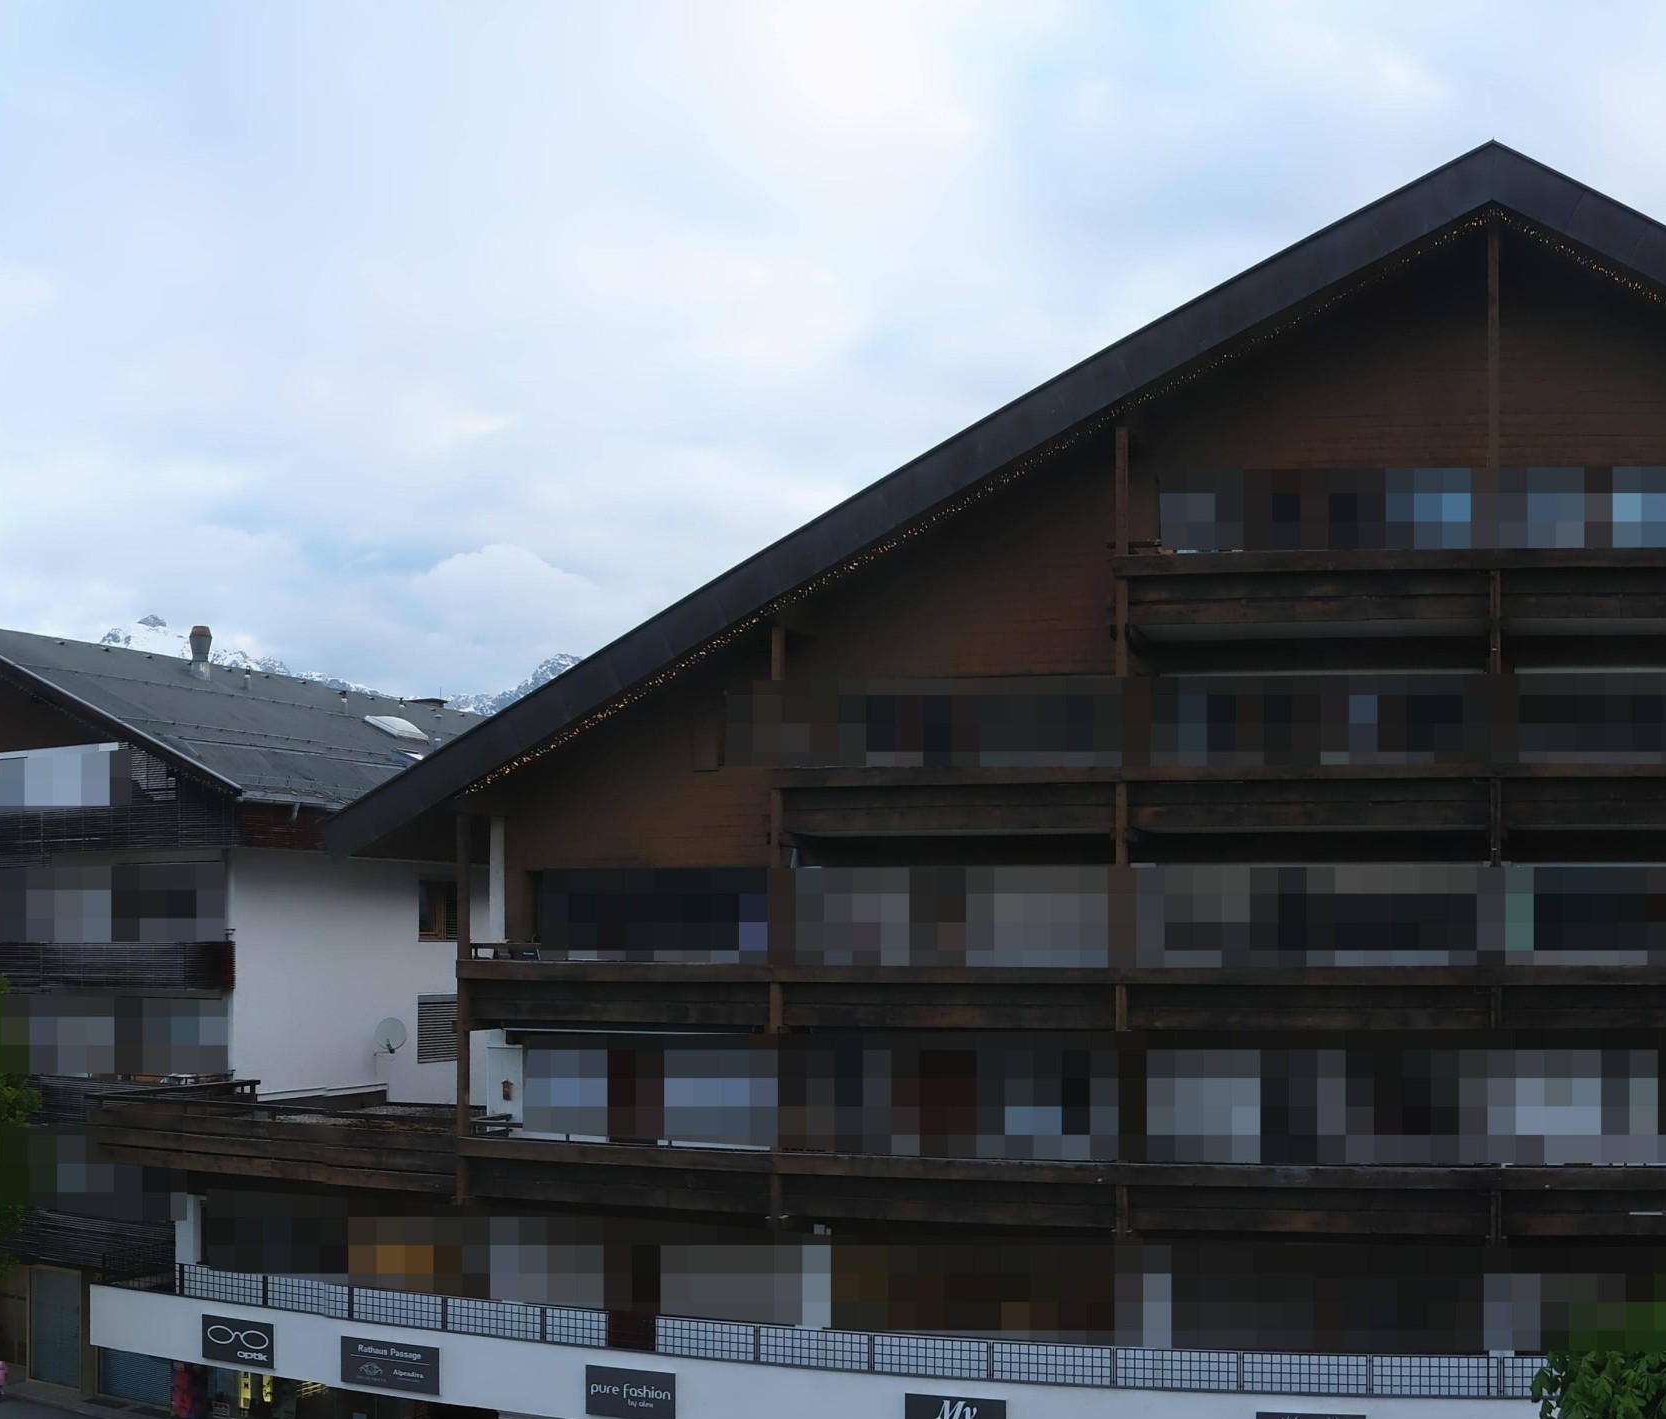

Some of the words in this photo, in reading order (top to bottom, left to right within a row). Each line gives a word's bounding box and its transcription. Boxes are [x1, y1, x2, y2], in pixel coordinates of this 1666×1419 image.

[236, 1350, 268, 1362] optik
[357, 1344, 388, 1356] Rathaus
[389, 1347, 422, 1361] Passage
[590, 1383, 620, 1396] pure
[623, 1383, 671, 1401] fashion
[627, 1399, 637, 1408] by
